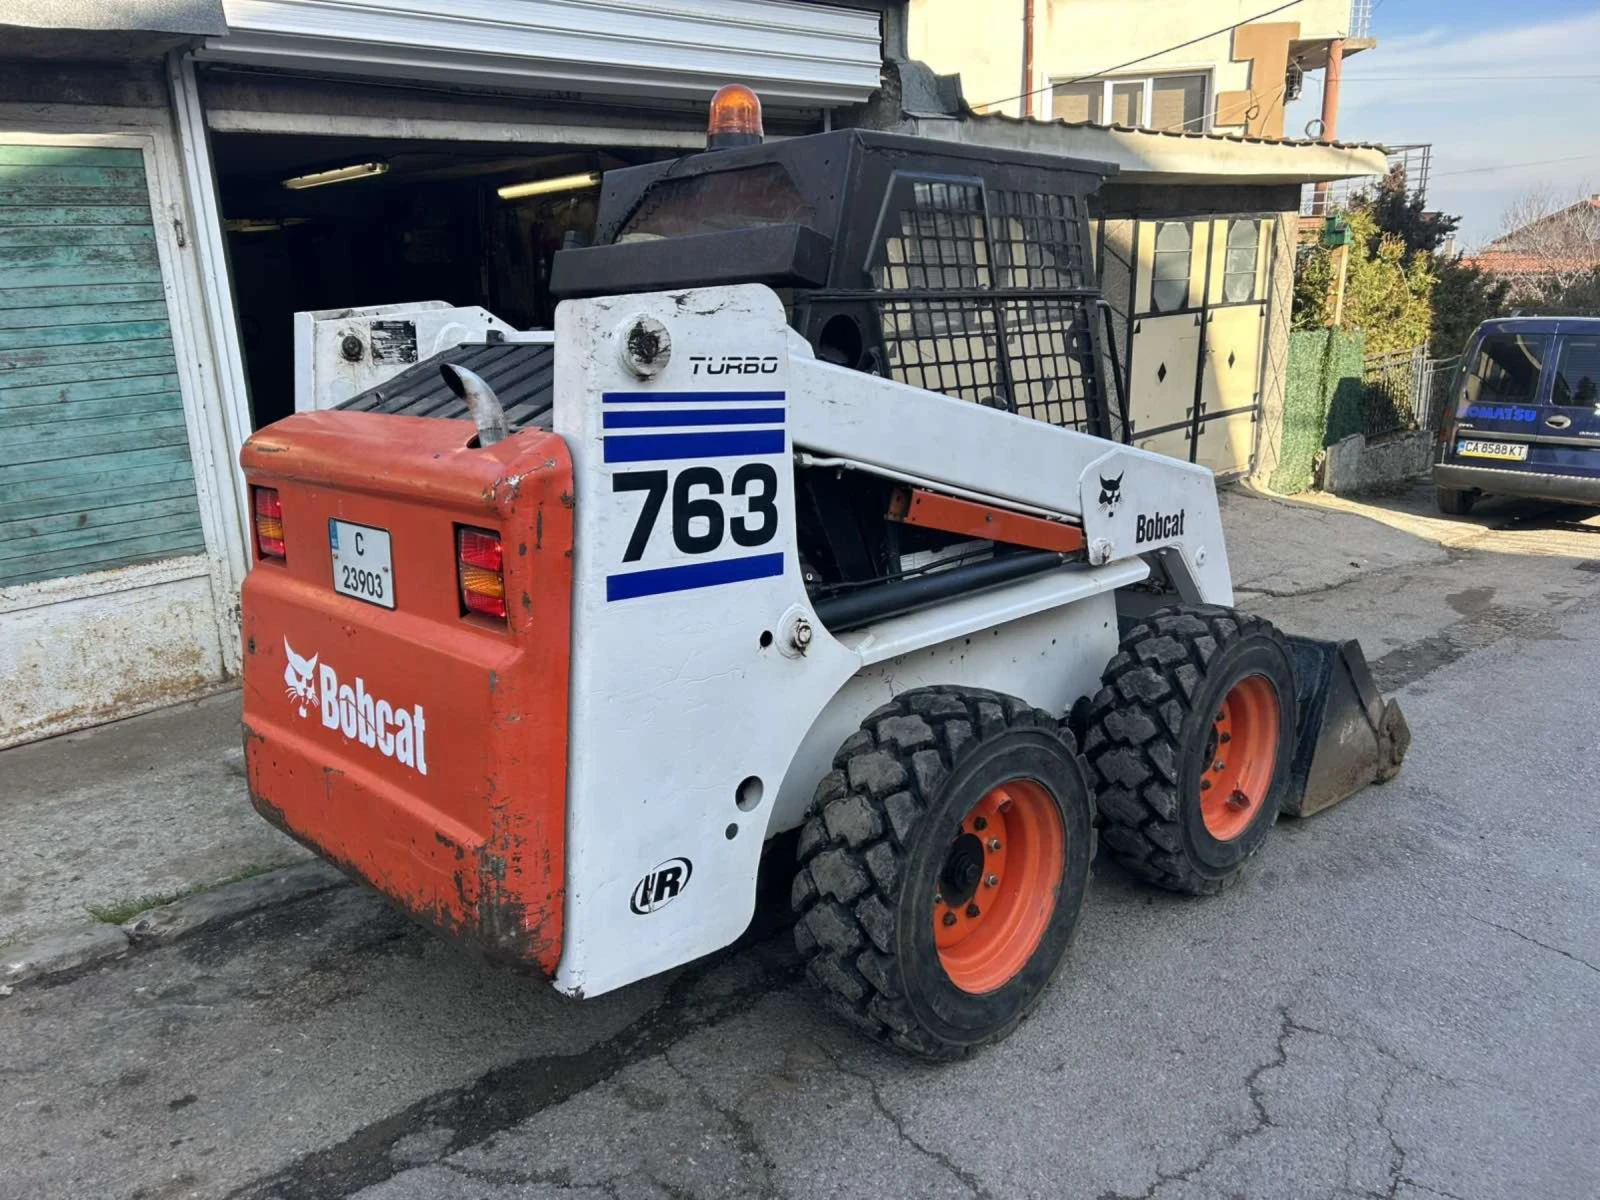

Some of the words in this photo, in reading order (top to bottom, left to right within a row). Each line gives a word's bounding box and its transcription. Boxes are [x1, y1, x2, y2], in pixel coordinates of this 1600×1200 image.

[689, 356, 778, 375] TURBO
[1461, 406, 1537, 422] OMATSU
[612, 463, 778, 563] 763
[1136, 508, 1184, 544] Bobcat
[355, 532, 364, 556] C
[342, 565, 383, 598] 23903
[319, 663, 427, 775] Bobcat
